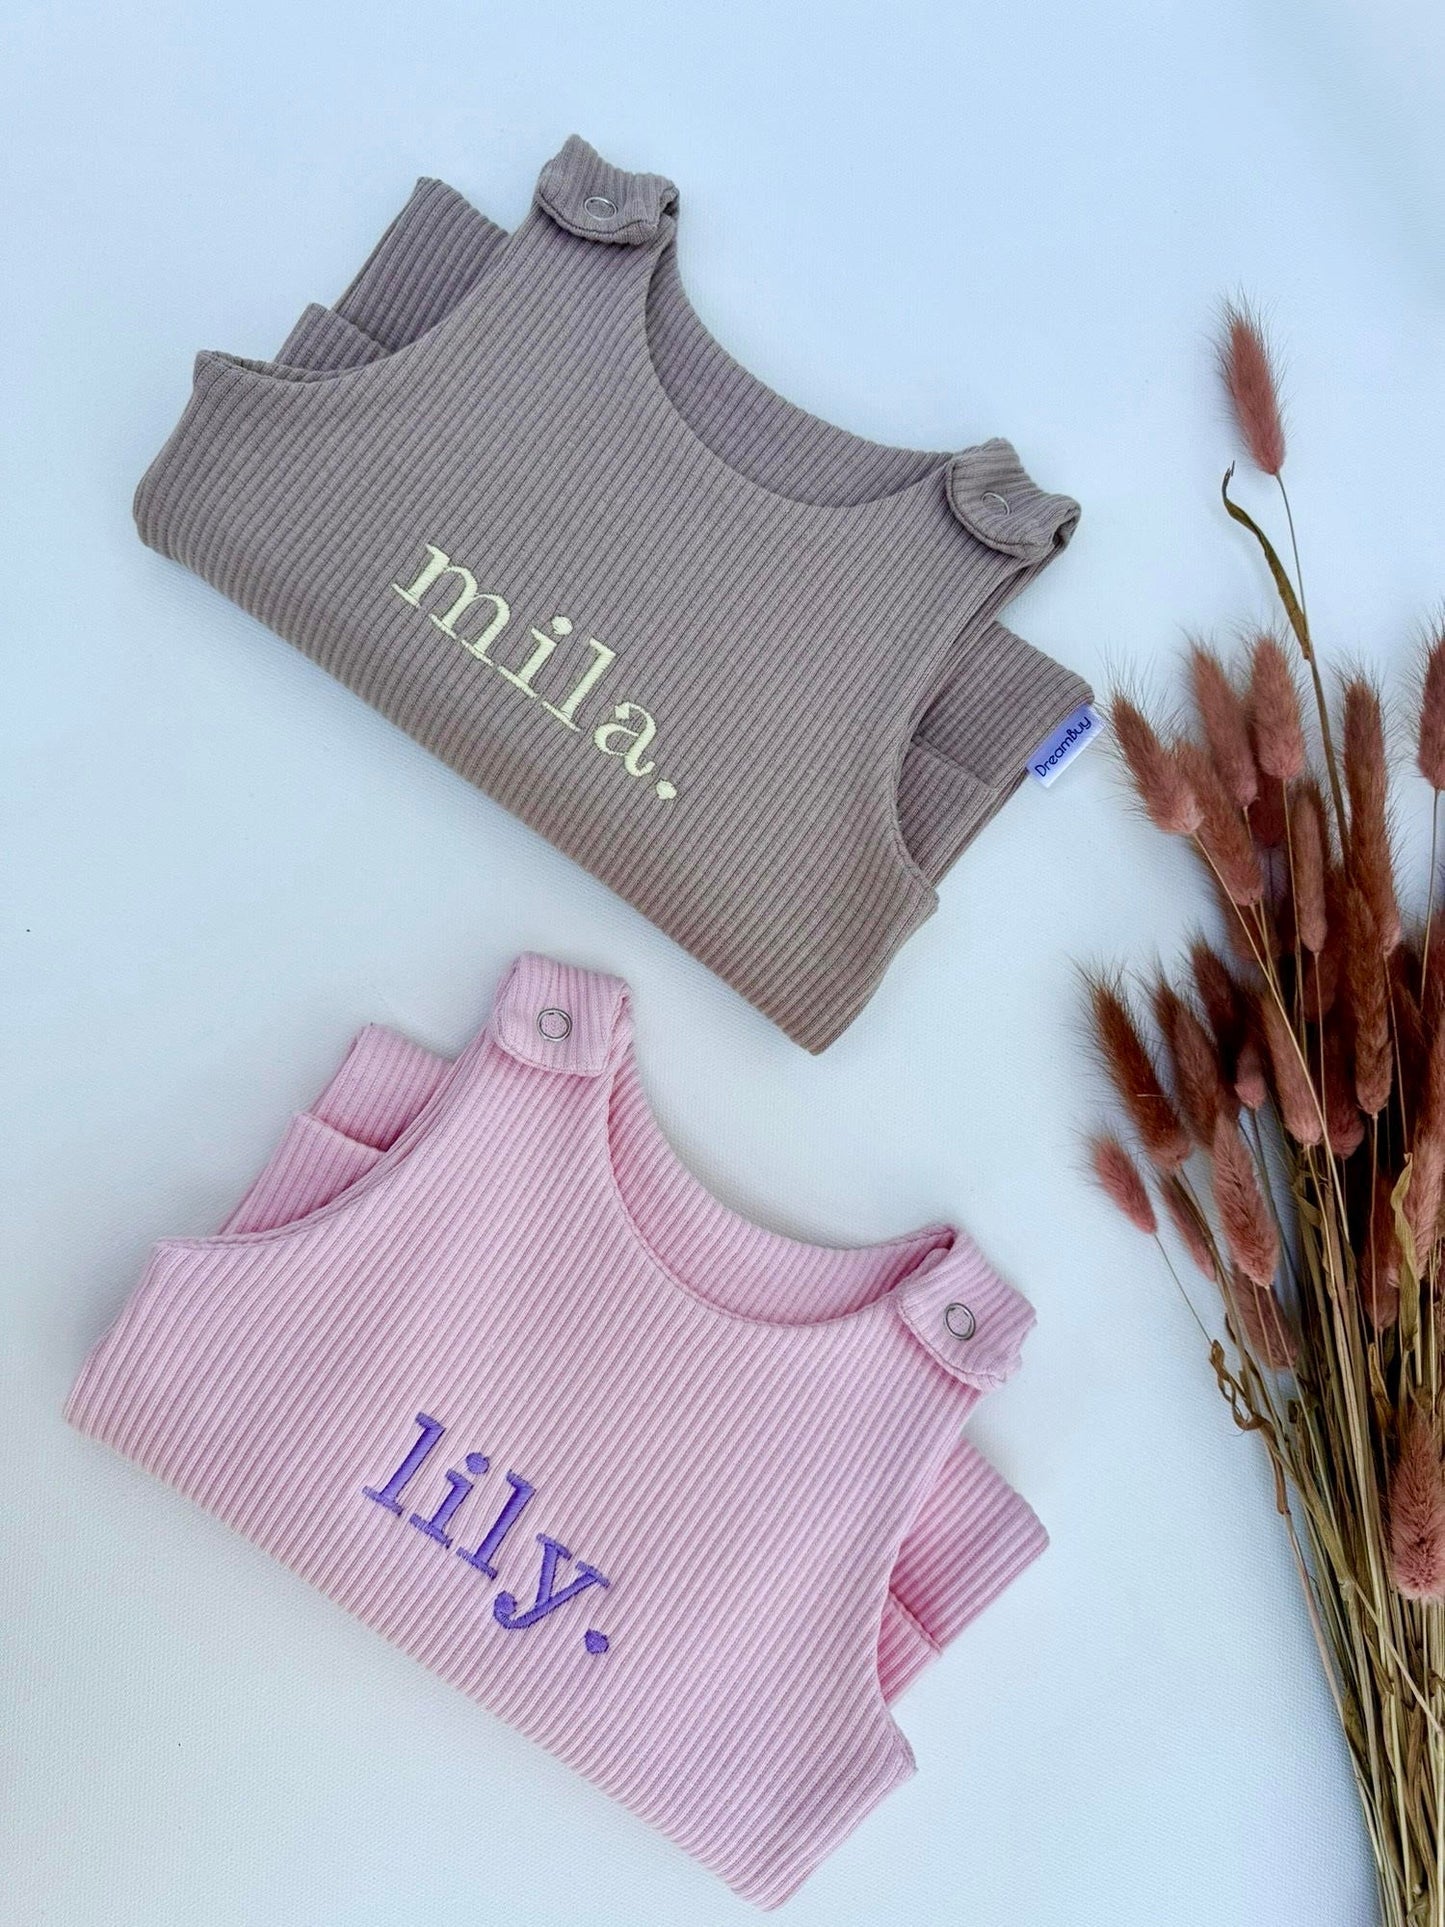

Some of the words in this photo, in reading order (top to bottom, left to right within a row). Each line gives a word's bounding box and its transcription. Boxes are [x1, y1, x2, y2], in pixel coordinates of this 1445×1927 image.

[391, 543, 678, 800] mila.
[1034, 716, 1092, 778] DreamBuy
[361, 1411, 611, 1655] lily.
